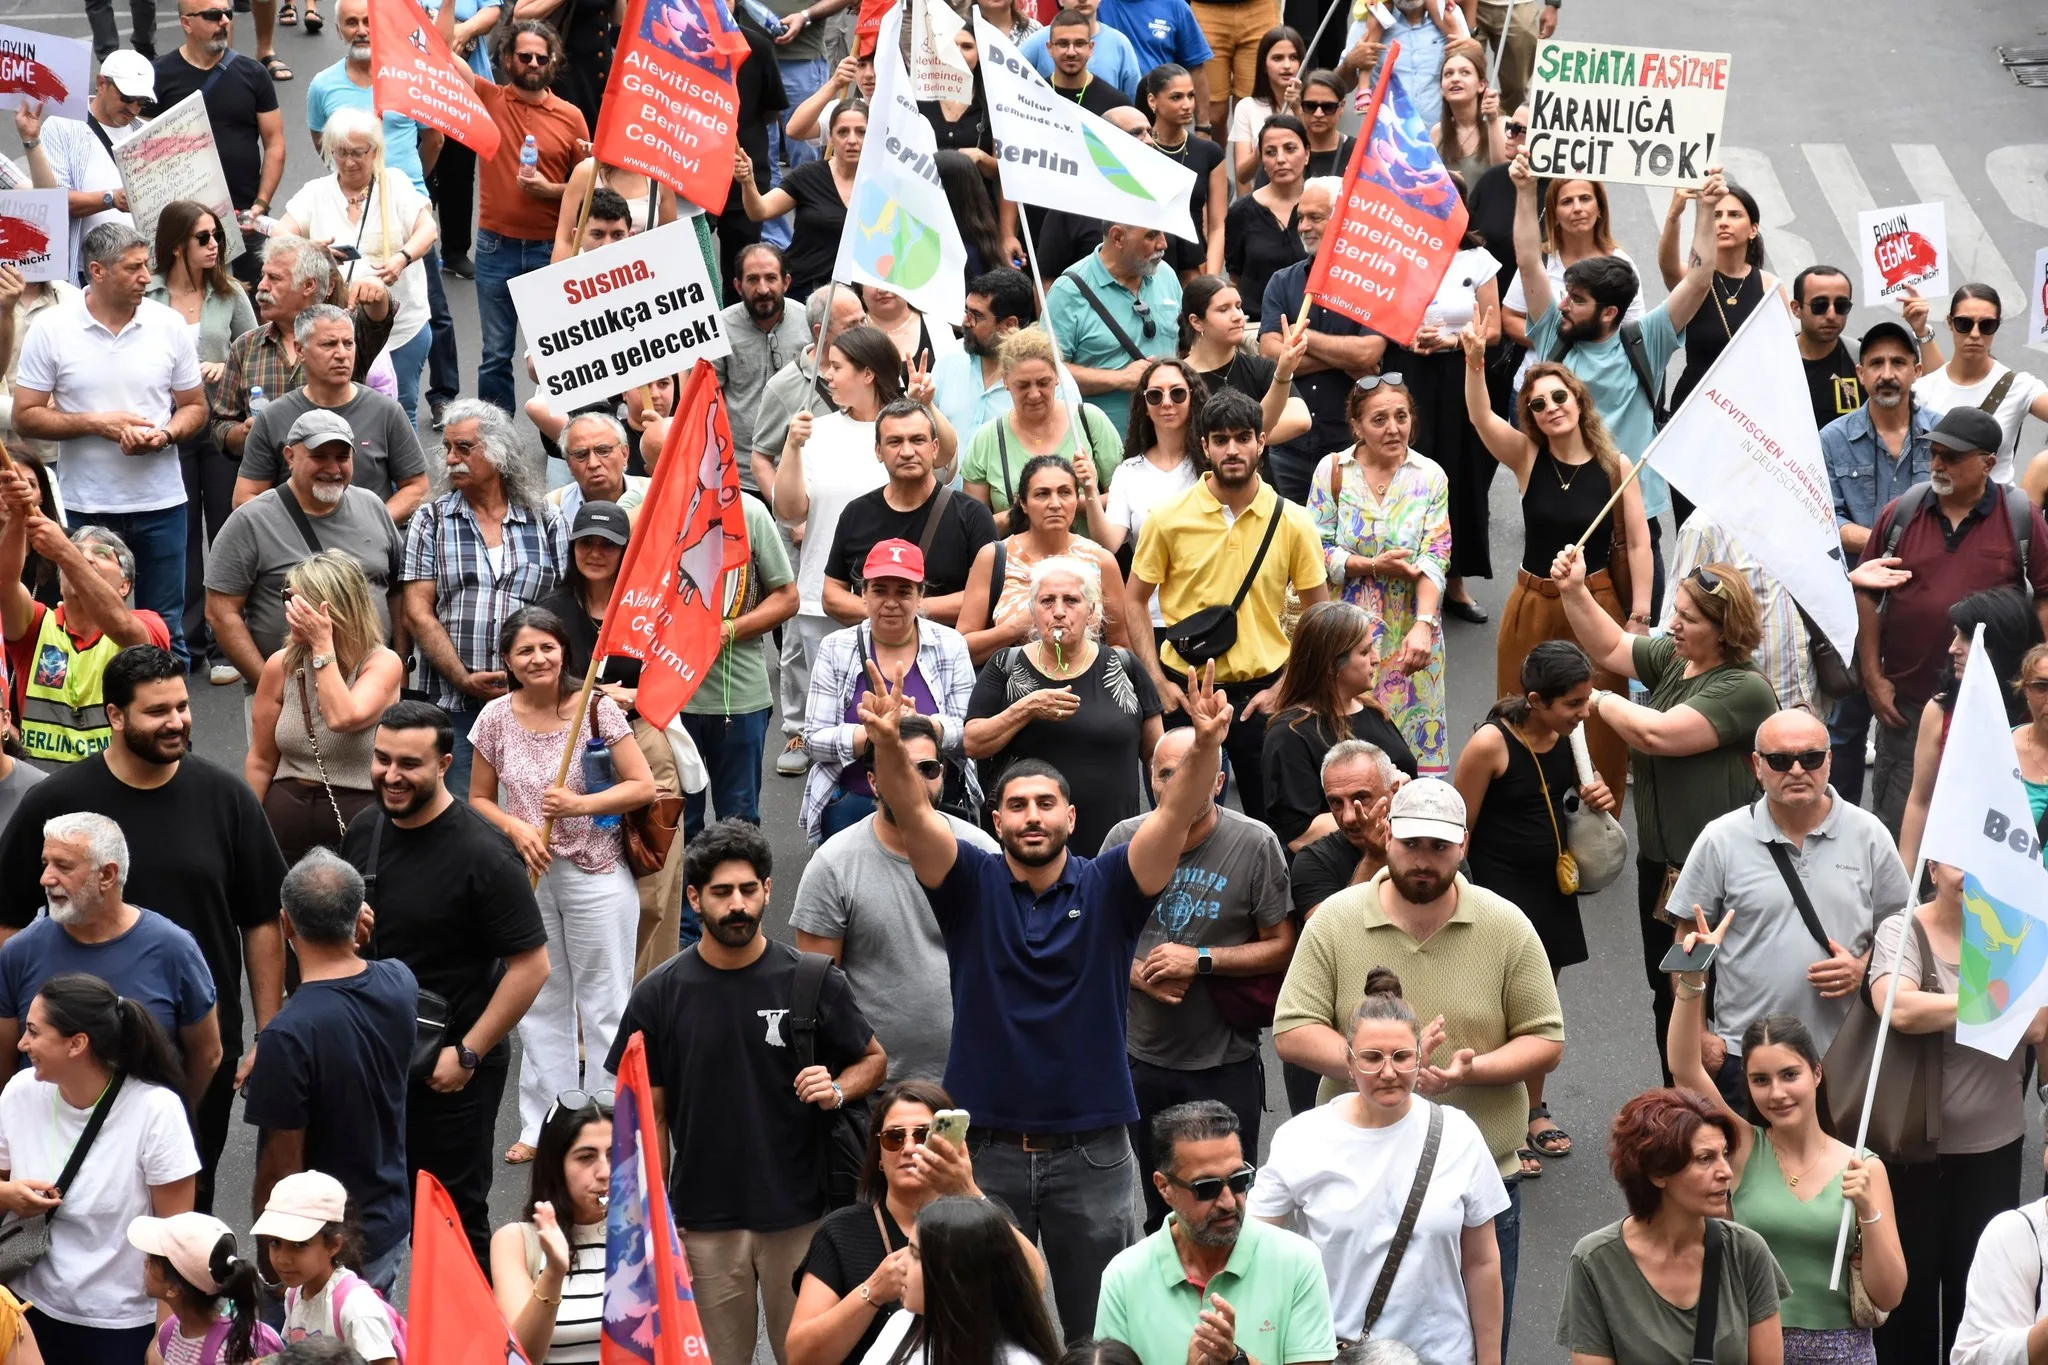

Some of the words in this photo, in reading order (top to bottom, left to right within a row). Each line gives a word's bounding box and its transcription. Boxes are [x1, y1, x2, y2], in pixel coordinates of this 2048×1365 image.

[0, 39, 36, 61] OYUN
[1537, 44, 1635, 87] ŞERİATA
[1638, 53, 1728, 90] FAŞİZME
[377, 65, 423, 86] Alevi
[414, 58, 465, 90] Berlin
[623, 50, 733, 114] Alevitische
[408, 86, 471, 125] Cemevi
[622, 74, 728, 135] Gemeinde
[995, 103, 1050, 126] Gemeinde
[1053, 123, 1074, 134] e.V.
[1017, 93, 1053, 113] Kultur
[1531, 89, 1675, 135] KARANLIĞA
[410, 107, 465, 140] www.alevi.org
[641, 103, 698, 148] Berlin
[625, 123, 700, 173] Cemevi
[1528, 132, 1614, 175] GEÇİT
[1628, 132, 1716, 179] YOK!
[623, 155, 684, 191] www.alevi.org
[1873, 213, 1909, 245] BOYUN
[19, 253, 51, 266] NICHT
[1333, 237, 1397, 277] Berlin
[1922, 268, 1939, 282] NICHT
[563, 259, 656, 305] Susma,
[1329, 264, 1396, 302] emevi
[537, 301, 651, 357] sustukça
[654, 282, 705, 316] sıra
[546, 358, 609, 396] sana
[611, 314, 720, 376] gelecek!
[1705, 388, 1785, 460] ALEVITISCHEN
[1740, 438, 1752, 453] IN
[1752, 449, 1820, 520] DEUTSCHLAND
